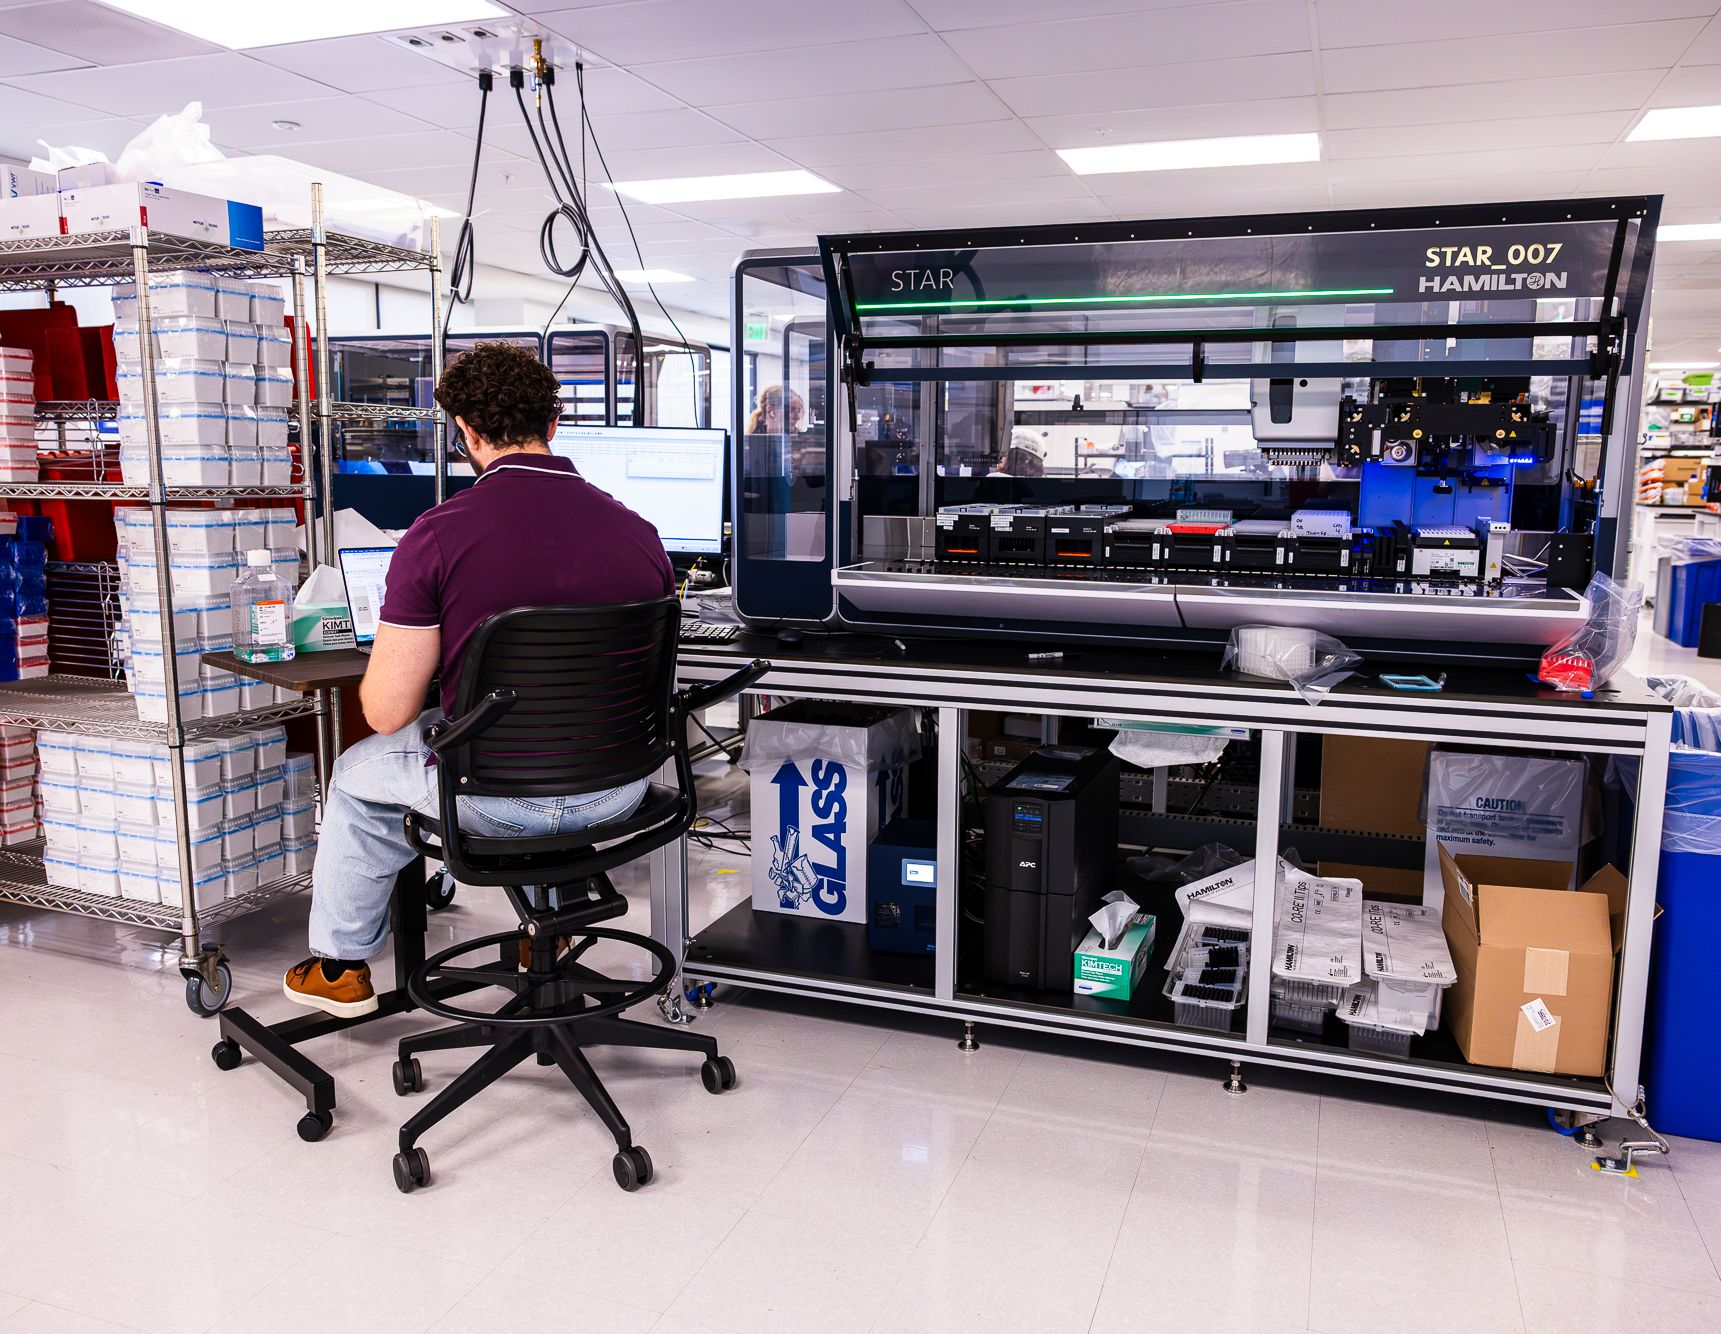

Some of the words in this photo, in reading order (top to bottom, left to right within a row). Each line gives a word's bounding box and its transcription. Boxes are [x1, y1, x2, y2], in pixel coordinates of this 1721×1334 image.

[1425, 243, 1563, 270] STAR_007
[891, 268, 954, 291] STAR
[1418, 272, 1568, 293] HAMILTON
[322, 620, 352, 630] KIMT
[811, 757, 848, 916] GLASS
[1436, 834, 1470, 844] maximum
[1471, 837, 1496, 846] safety.
[1187, 877, 1234, 900] HAMILTON
[1081, 959, 1123, 972] KIMTECH
